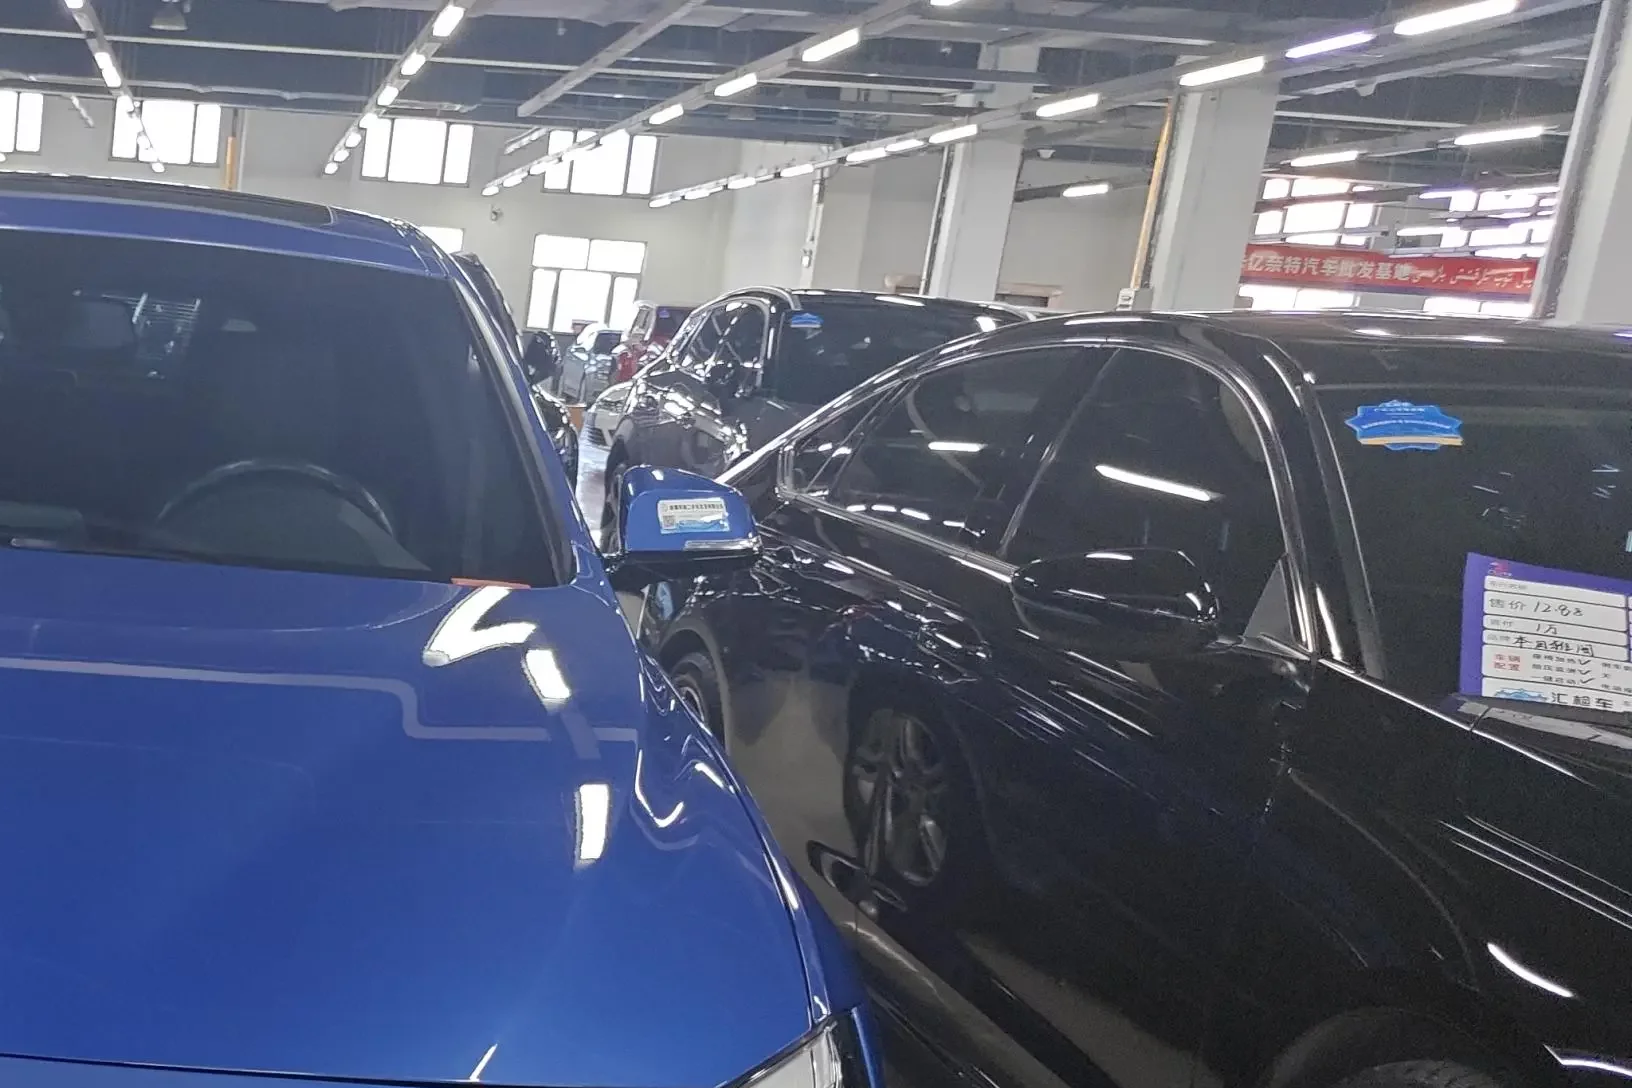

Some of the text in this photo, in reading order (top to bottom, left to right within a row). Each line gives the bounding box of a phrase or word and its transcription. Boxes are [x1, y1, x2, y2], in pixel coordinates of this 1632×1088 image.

[1241, 252, 1412, 281] 亿奈特汽车批发基地
